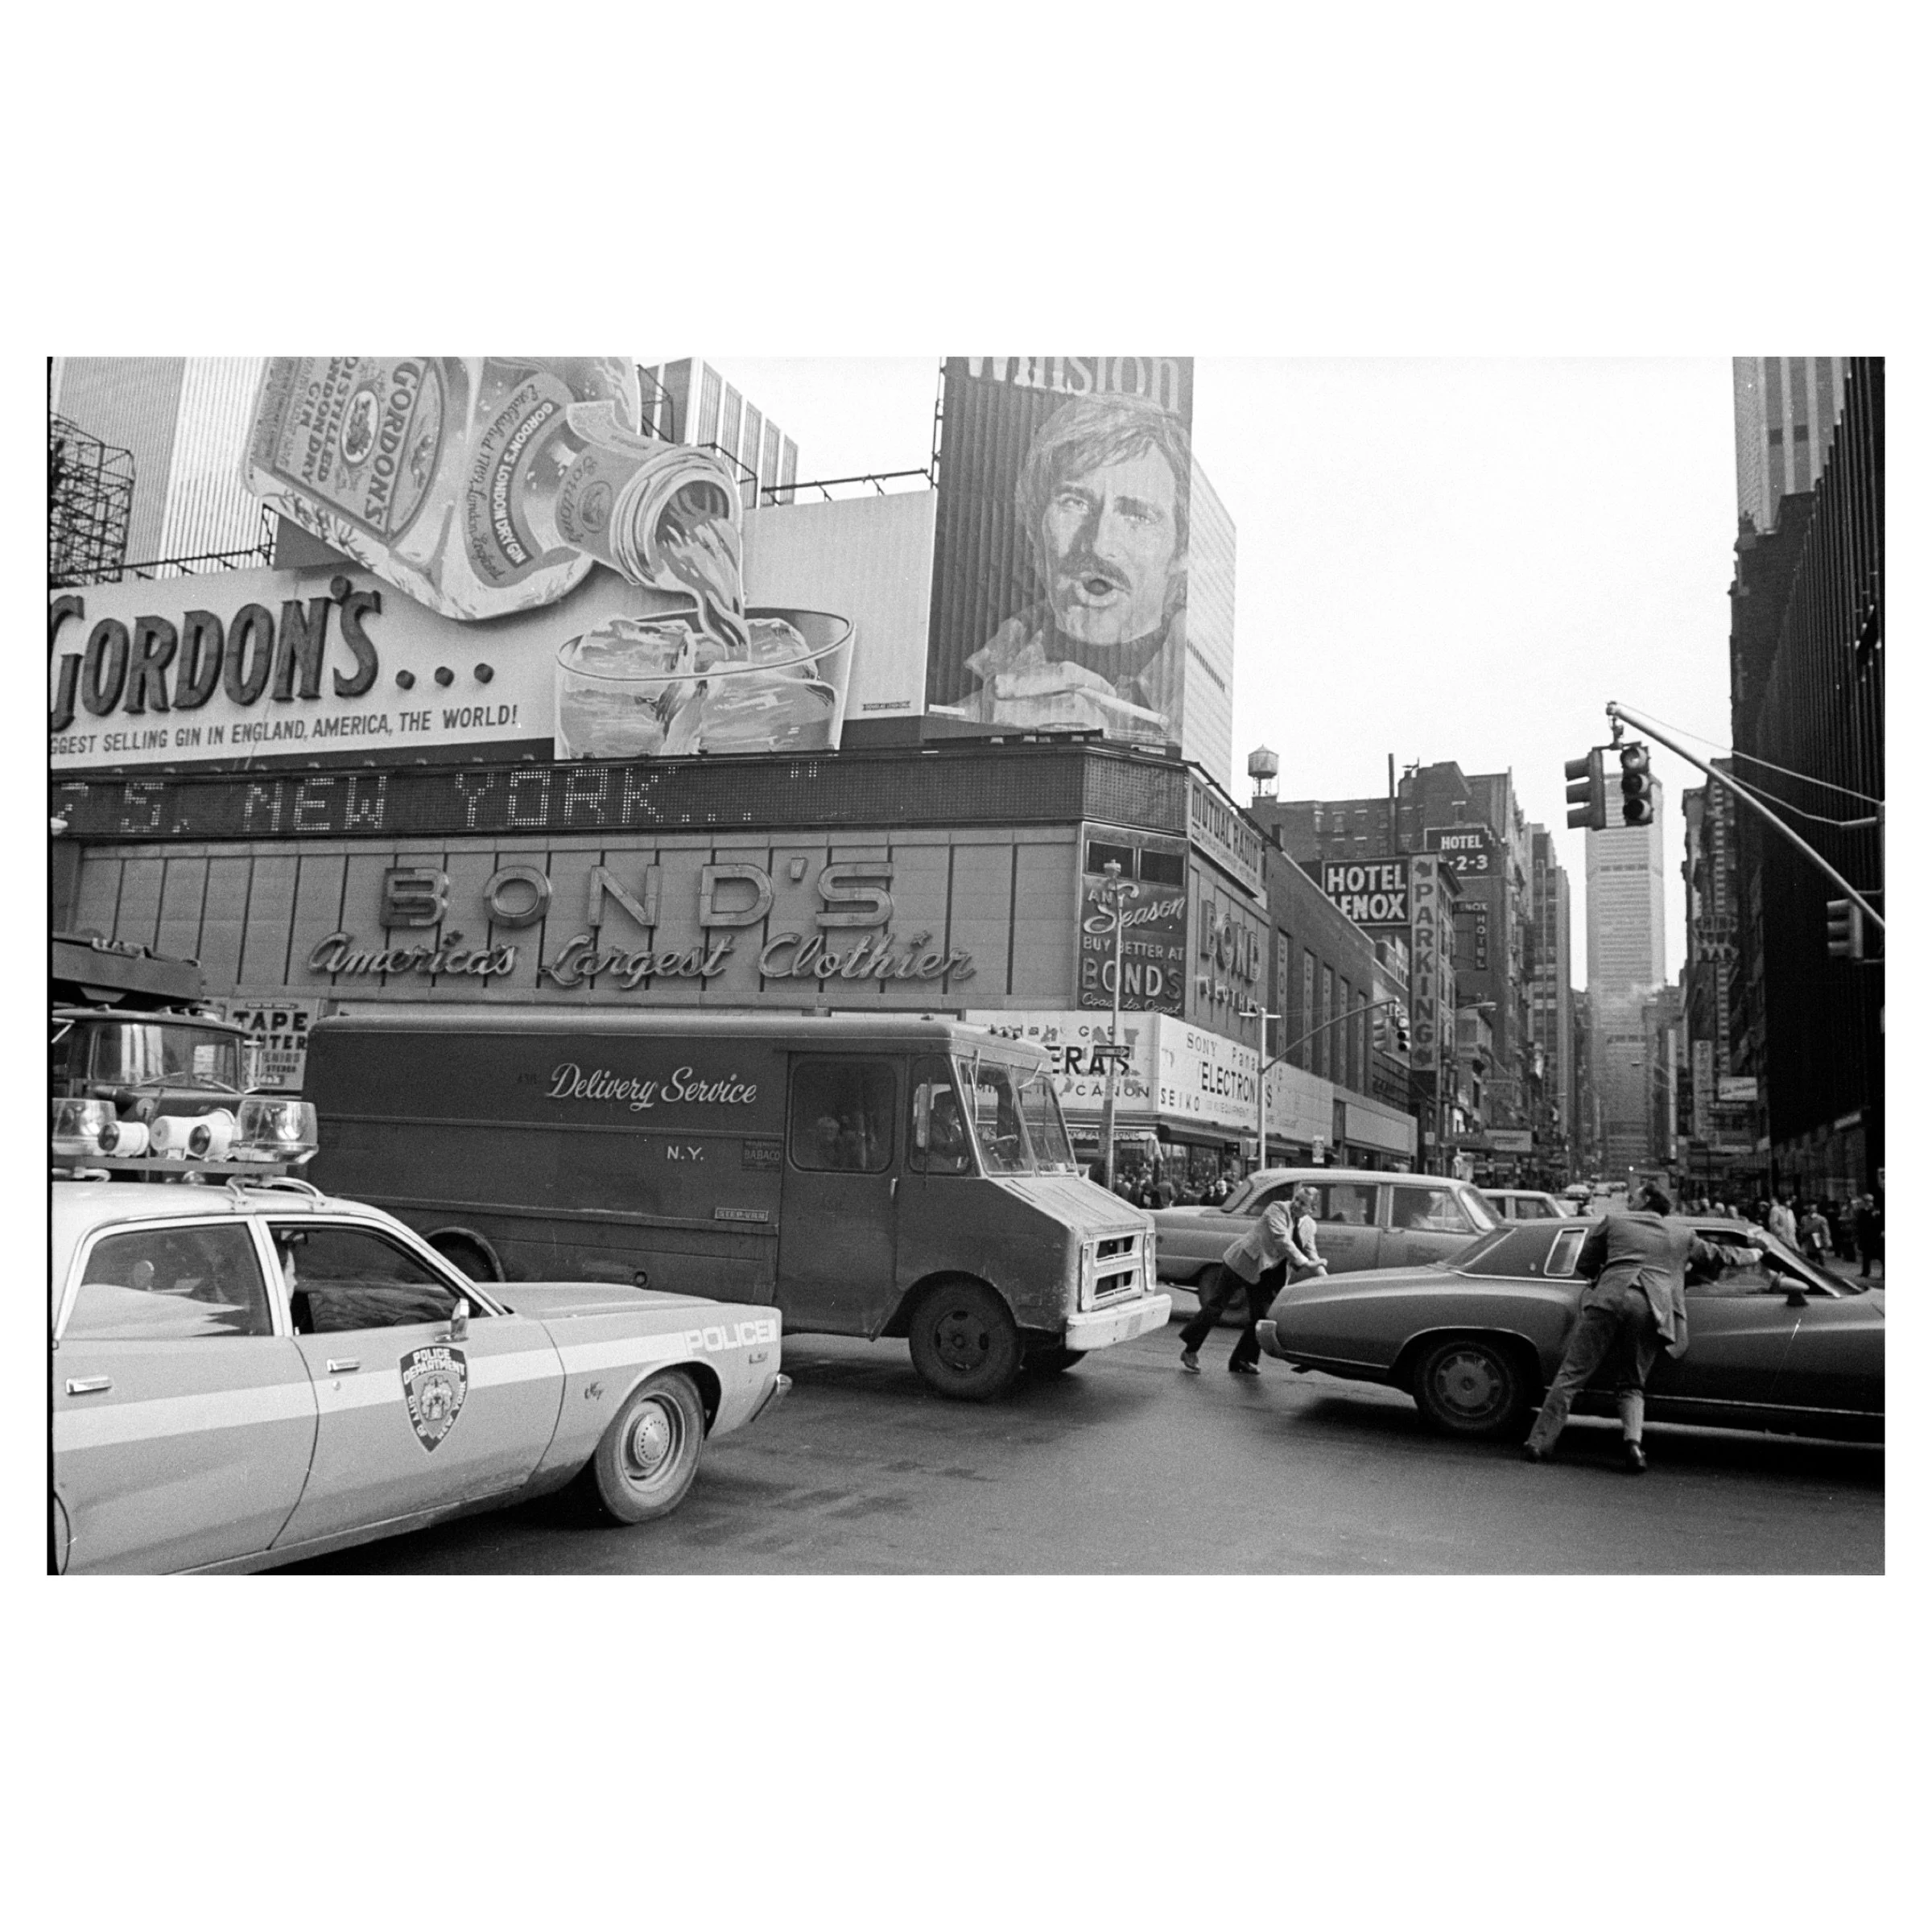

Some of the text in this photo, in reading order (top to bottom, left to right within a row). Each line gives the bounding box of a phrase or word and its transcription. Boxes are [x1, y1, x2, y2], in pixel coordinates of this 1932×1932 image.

[299, 381, 320, 427] GIN
[318, 357, 360, 482] DISTILLED
[301, 433, 322, 483] DRY
[365, 362, 420, 525] GORDON'S
[493, 402, 553, 564] GORDON'S LONDON DRY GIN
[103, 729, 167, 752] SELLING
[175, 727, 201, 747] GIN
[208, 725, 224, 745] IN
[232, 719, 308, 744] ENGLAND,
[312, 713, 392, 737] AMERICA,
[399, 710, 432, 732] THE
[444, 704, 518, 729] WORLD!
[243, 776, 386, 832] NEW
[1440, 835, 1483, 849] HOTEL
[379, 858, 894, 928] BOND'S
[1088, 889, 1125, 907] ANY
[1328, 865, 1406, 892] HOTEL
[1084, 883, 1185, 934] Season
[538, 931, 733, 989] Largest
[758, 930, 976, 980] Clothier
[1084, 936, 1111, 952] BUY
[1167, 947, 1184, 961] AT
[1201, 899, 1260, 981] BOND
[1415, 883, 1434, 1043] PARKING
[1476, 914, 1486, 968] HOTEL
[233, 1011, 308, 1032] TAPE
[1187, 1032, 1216, 1057] SONY
[545, 1063, 758, 1112] Delivery Service
[1160, 1088, 1200, 1112] SEIKO
[1202, 1062, 1272, 1108] ELECTRONS
[667, 1146, 704, 1161] N.Y.
[412, 1348, 451, 1364] POLICE
[686, 1320, 771, 1356] POLICE
[403, 1358, 464, 1385] DEPARTMENT
[408, 1381, 466, 1439] CITY OF NEW YORK
